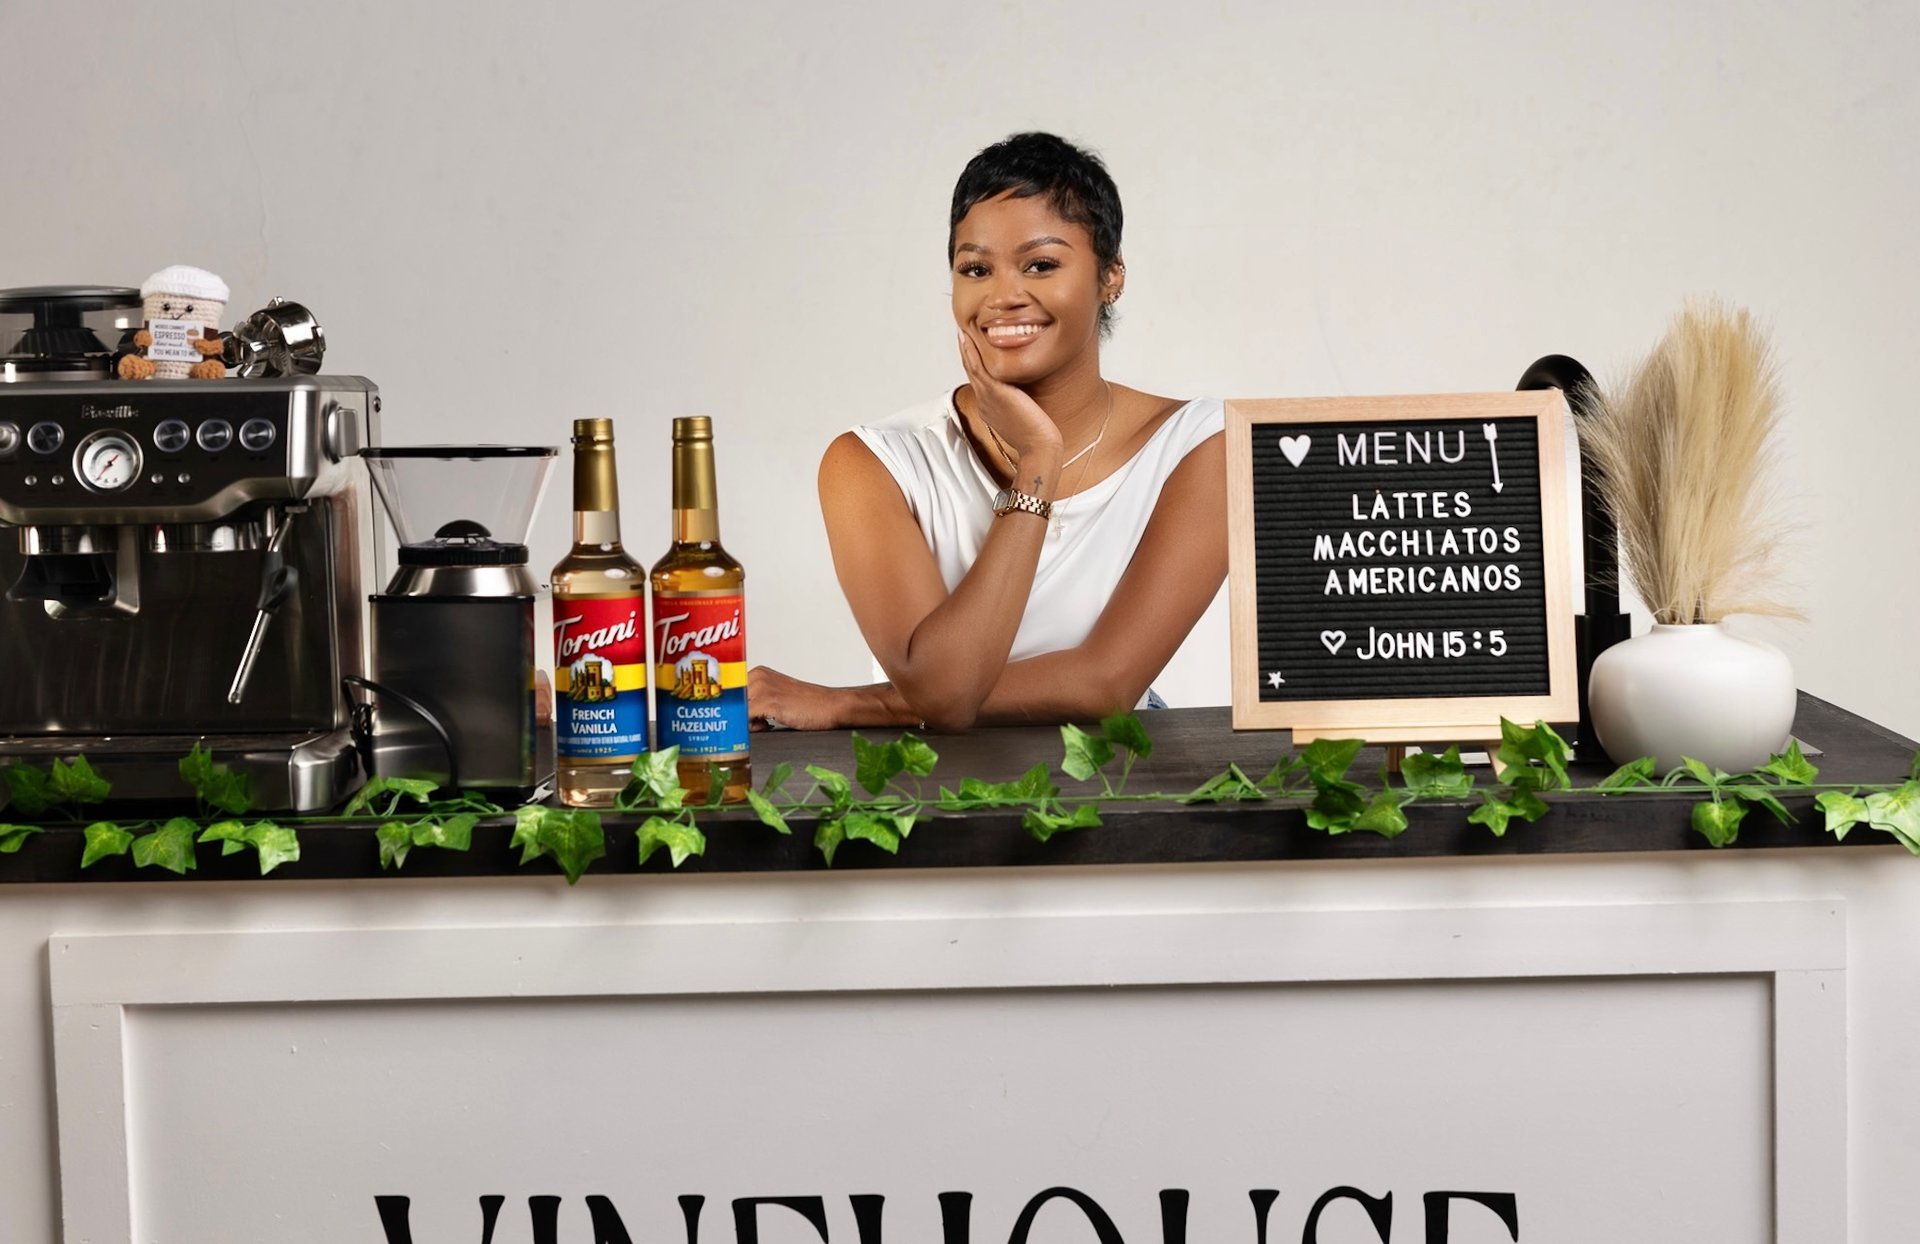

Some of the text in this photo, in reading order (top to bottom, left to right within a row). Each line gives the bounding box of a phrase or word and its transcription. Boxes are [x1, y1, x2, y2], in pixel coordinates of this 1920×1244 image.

[154, 331, 185, 340] ESPRESSO
[1337, 430, 1466, 466] MENU
[1352, 491, 1472, 520] LATTES
[1313, 527, 1521, 561] MACCHIATOS
[1323, 564, 1522, 595] AMERICANOS
[553, 610, 637, 669] Torani
[655, 609, 741, 667] Torani
[1356, 626, 1434, 660] JOHN
[571, 721, 618, 734] VANILLA
[572, 708, 615, 720] FRENCH
[671, 720, 728, 732] HAZELNUT
[676, 706, 721, 719] CLASSIC
